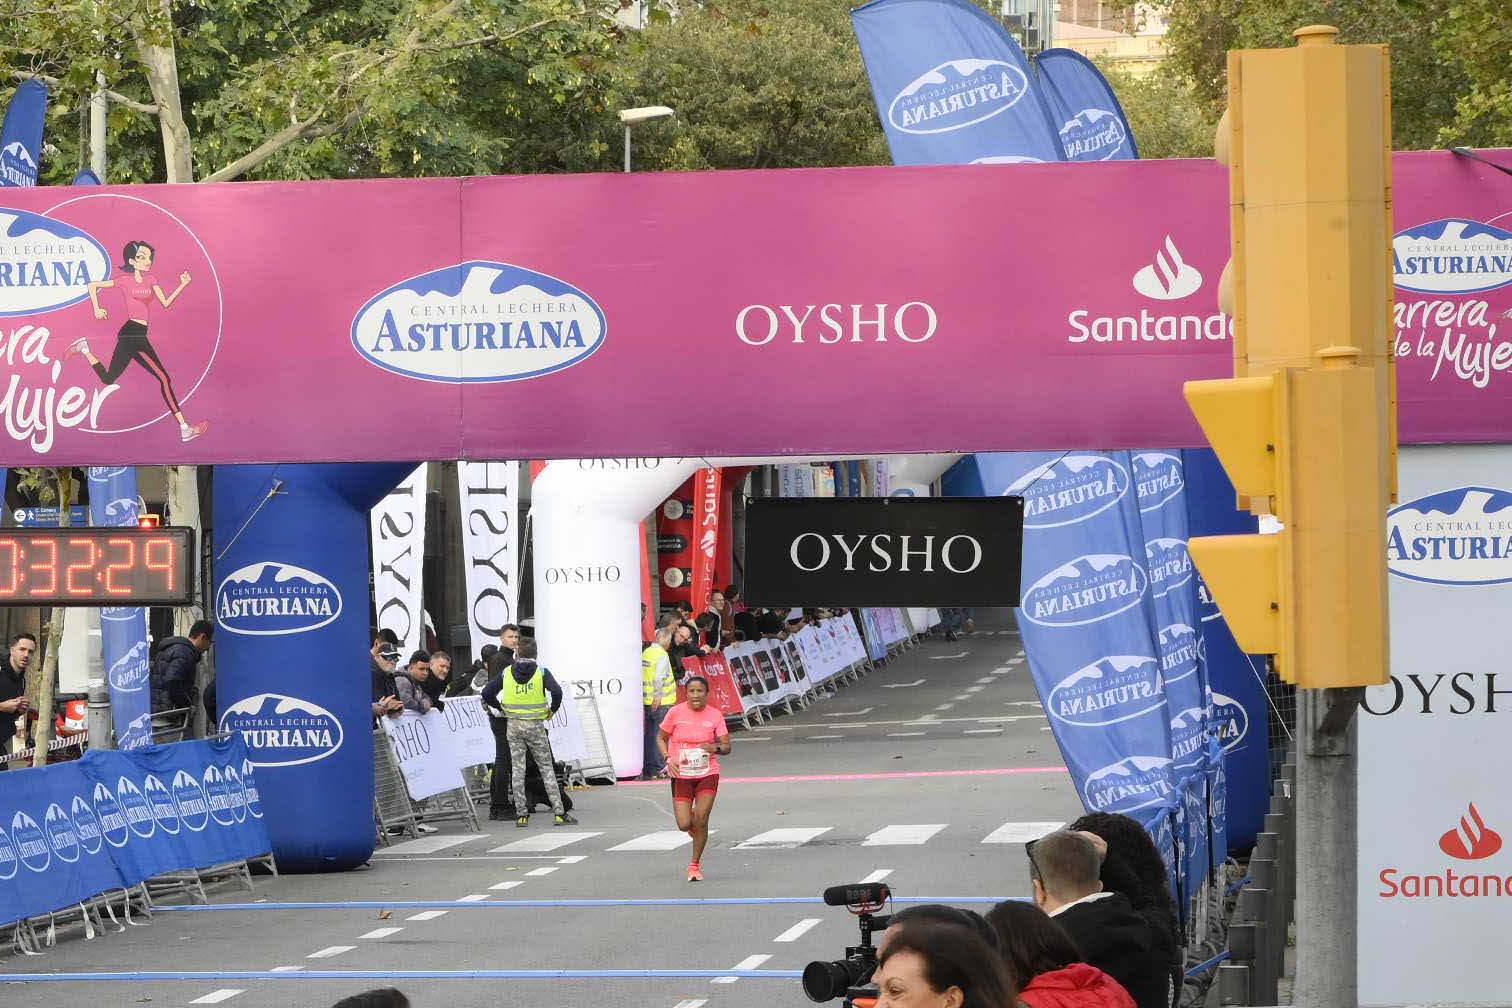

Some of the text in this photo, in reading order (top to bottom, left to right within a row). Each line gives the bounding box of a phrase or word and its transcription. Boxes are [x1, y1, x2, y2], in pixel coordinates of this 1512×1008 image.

[13, 243, 86, 256] LECHERA
[1407, 243, 1512, 253] CENTRAL LECHER
[410, 302, 578, 317] CENTRAL LECHERA
[1393, 299, 1489, 329] arrera
[371, 308, 587, 353] ASTURIANA
[734, 301, 938, 346] OYSHO
[1416, 329, 1435, 357] la
[1414, 521, 1482, 532] CENTRAL
[789, 532, 983, 574] OYSHO
[545, 565, 621, 585] OYSHO
[232, 586, 329, 596] CENTRAL LECHERA
[219, 591, 334, 619] ASTURIANA
[279, 718, 329, 727] LECHERA
